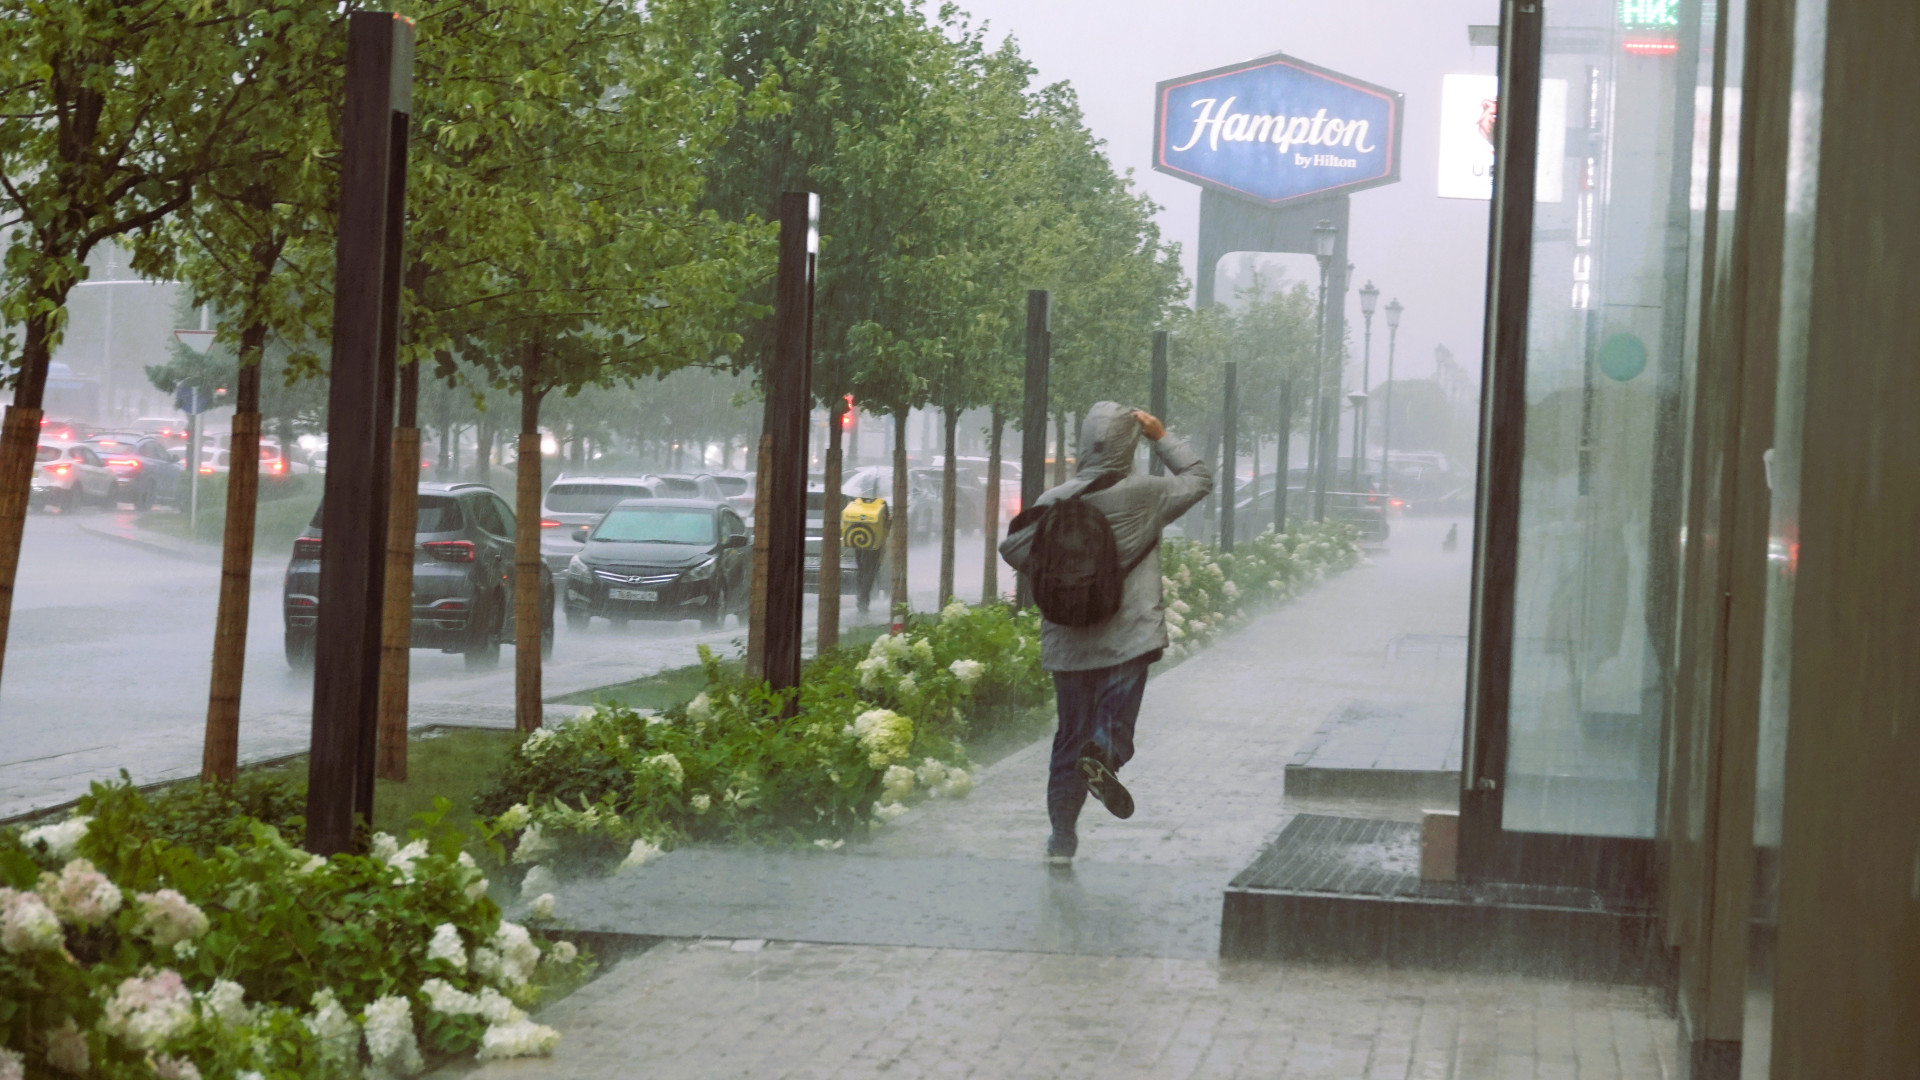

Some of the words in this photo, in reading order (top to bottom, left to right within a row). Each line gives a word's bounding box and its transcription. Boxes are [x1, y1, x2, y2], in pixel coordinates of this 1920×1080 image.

[1172, 96, 1376, 154] Hampton
[1294, 153, 1312, 169] by
[1313, 154, 1357, 168] Hilton
